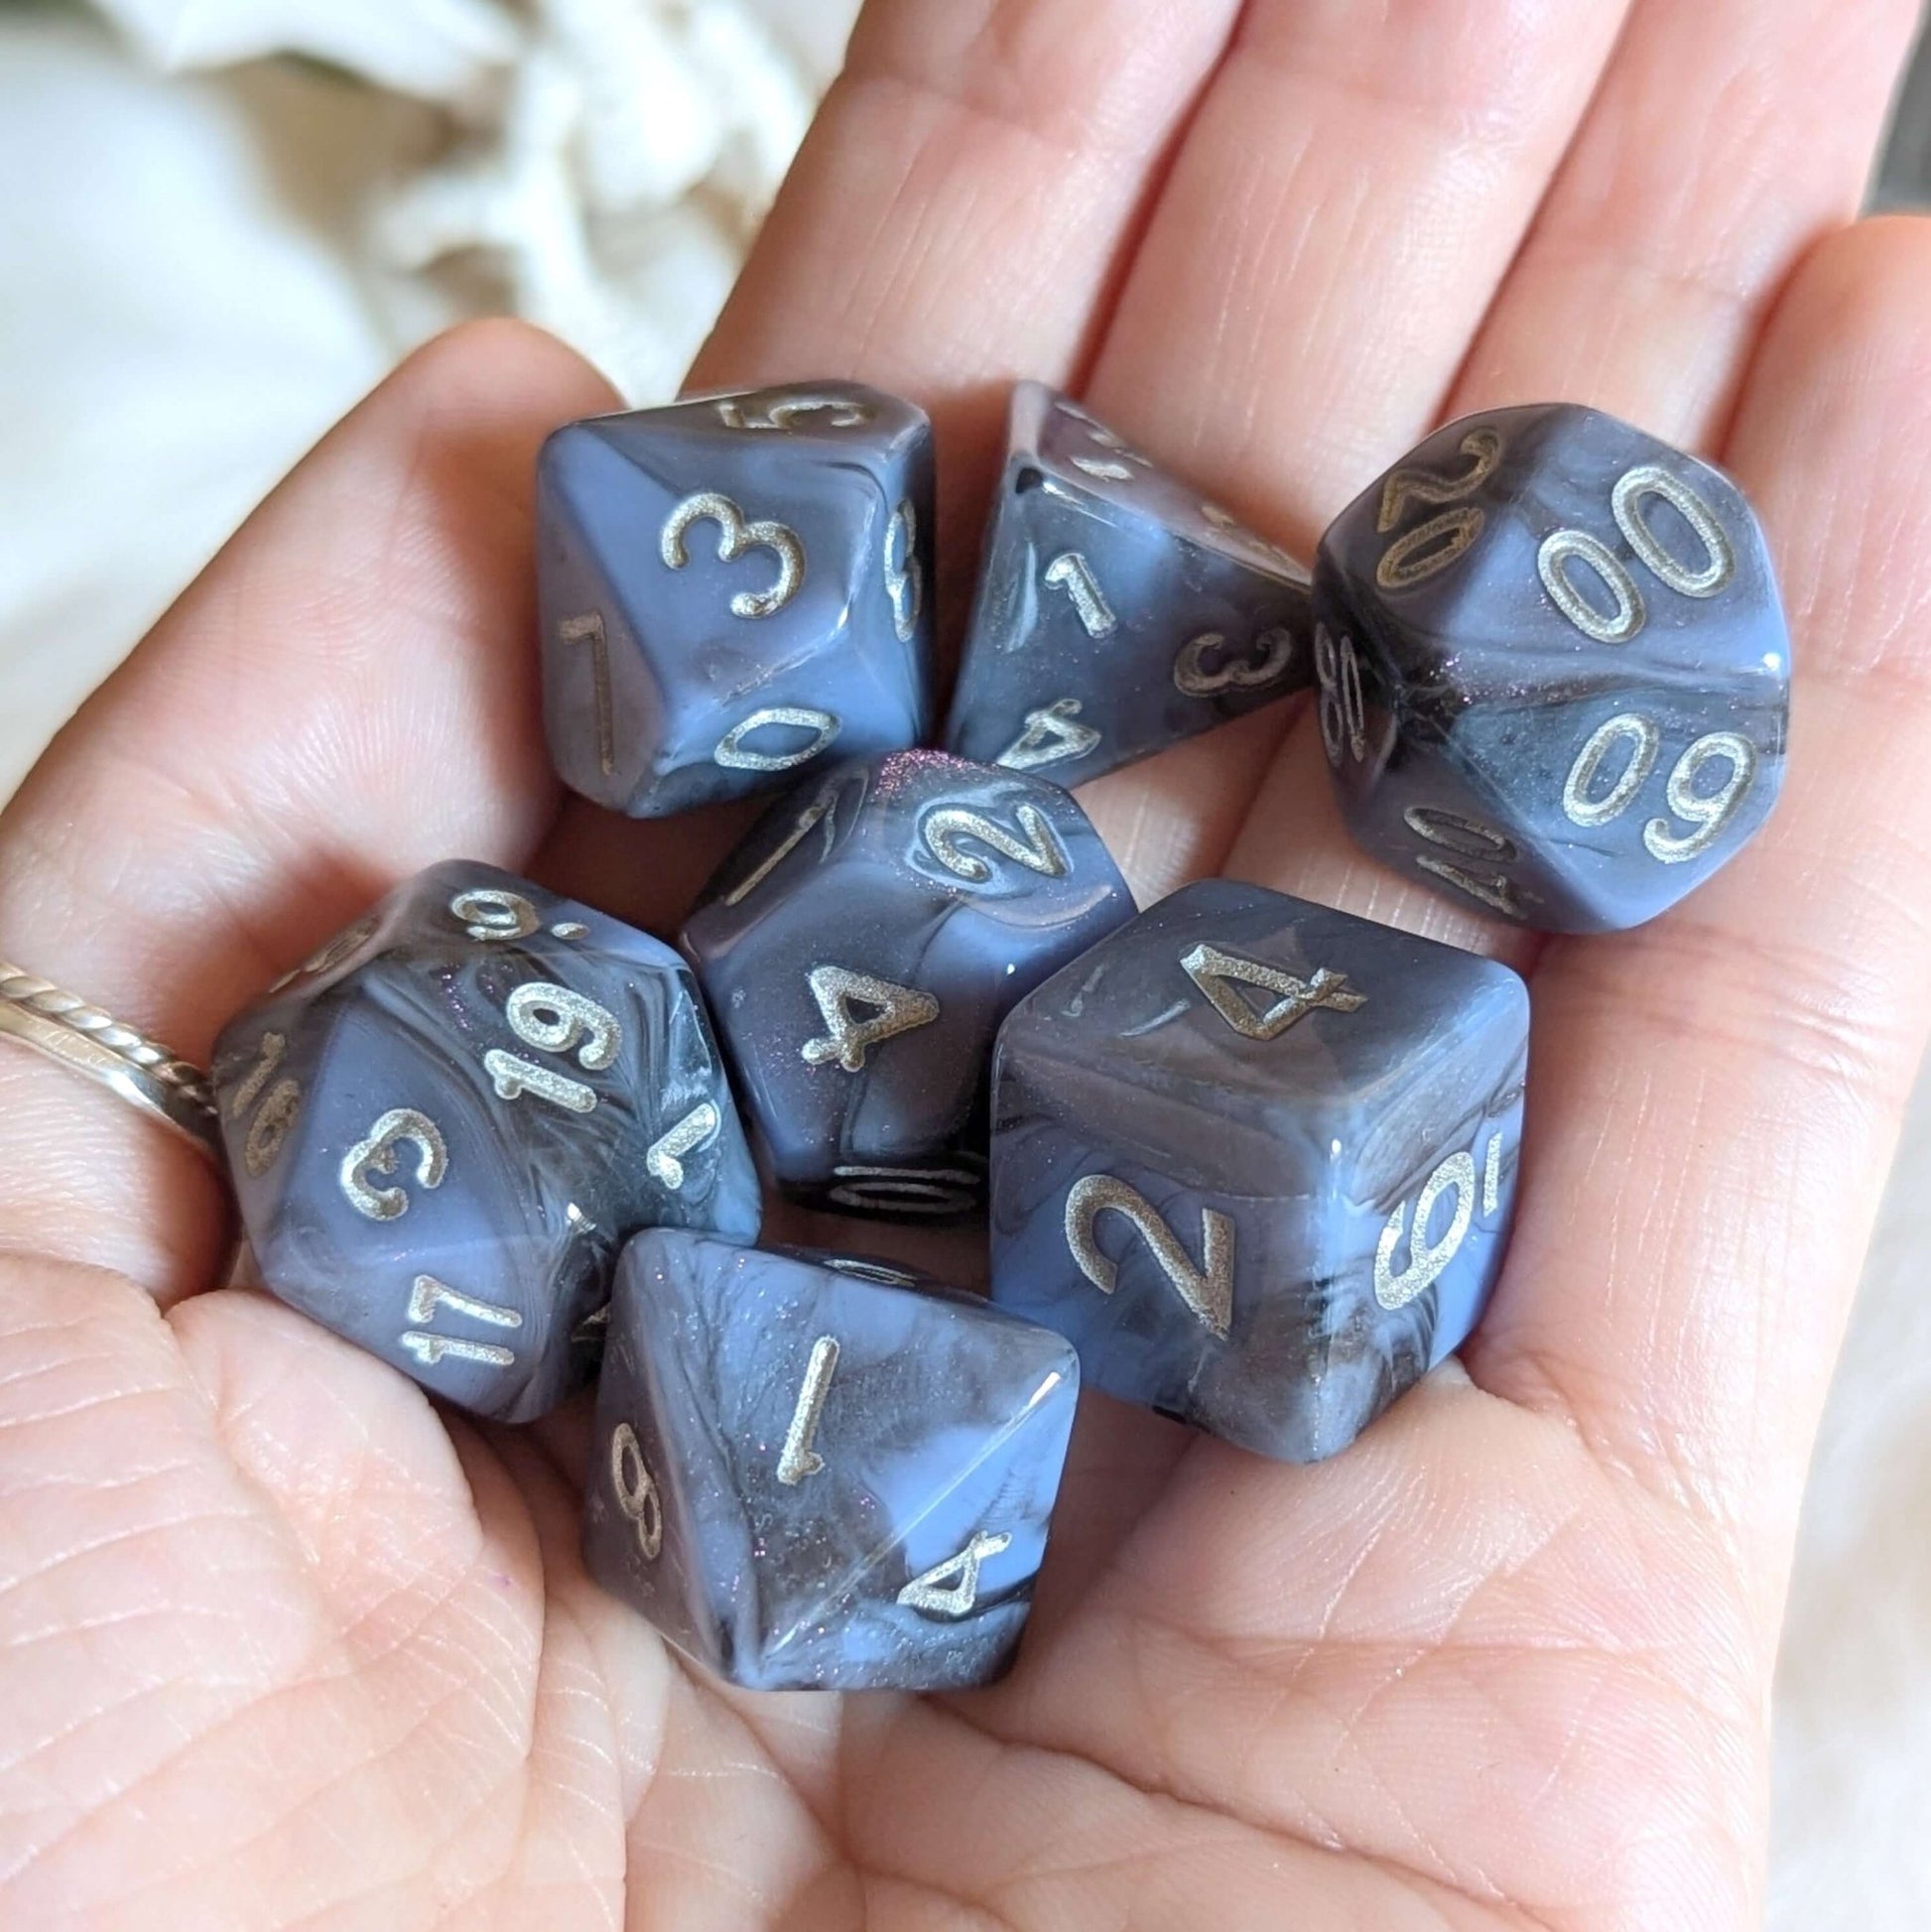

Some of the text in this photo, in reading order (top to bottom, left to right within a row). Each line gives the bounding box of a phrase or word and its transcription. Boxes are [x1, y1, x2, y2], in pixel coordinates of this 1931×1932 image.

[661, 493, 805, 619] 3
[1376, 425, 1504, 589] 20
[1537, 466, 1735, 643] 00
[1045, 553, 1117, 638] 1
[1174, 628, 1293, 698] 3
[714, 708, 841, 771] 0
[996, 698, 1101, 771] 4
[924, 805, 1069, 881] 2
[802, 965, 940, 1073] 4
[1179, 941, 1367, 1040] 4
[484, 981, 622, 1113] 19
[341, 1108, 449, 1221] 3
[1065, 1174, 1235, 1341] 2
[402, 1274, 522, 1365] 17
[777, 1335, 840, 1484] 1
[611, 1423, 662, 1559] 8
[896, 1529, 1013, 1617] 4
